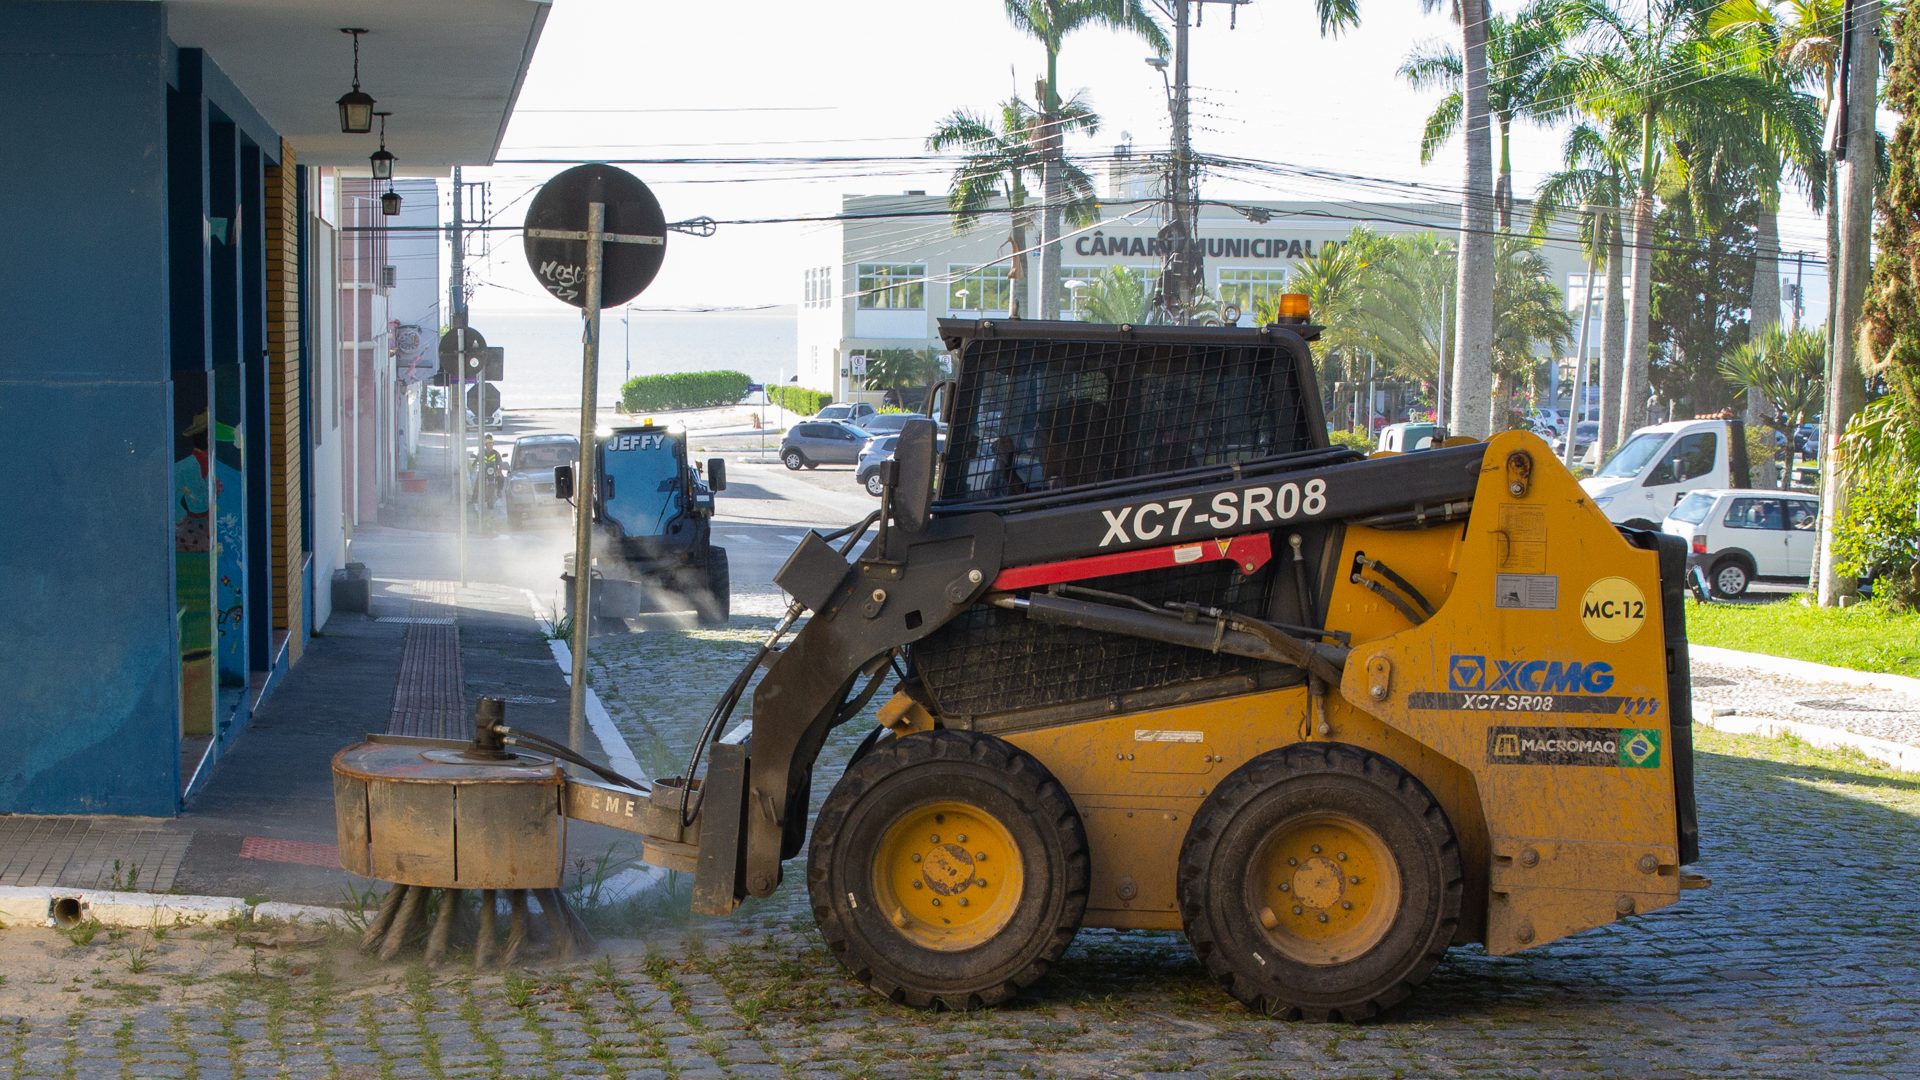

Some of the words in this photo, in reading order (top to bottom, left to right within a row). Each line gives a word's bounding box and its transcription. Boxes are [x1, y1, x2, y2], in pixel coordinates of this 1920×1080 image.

[1075, 230, 1168, 257] CÂMAR
[608, 435, 665, 451] JEFFY
[1099, 478, 1327, 547] XC7-SR08
[1583, 601, 1644, 618] MC-12
[1485, 660, 1614, 693] XCMG
[1462, 694, 1553, 711] XC7-SR08
[1521, 739, 1616, 754] MACROMAQ
